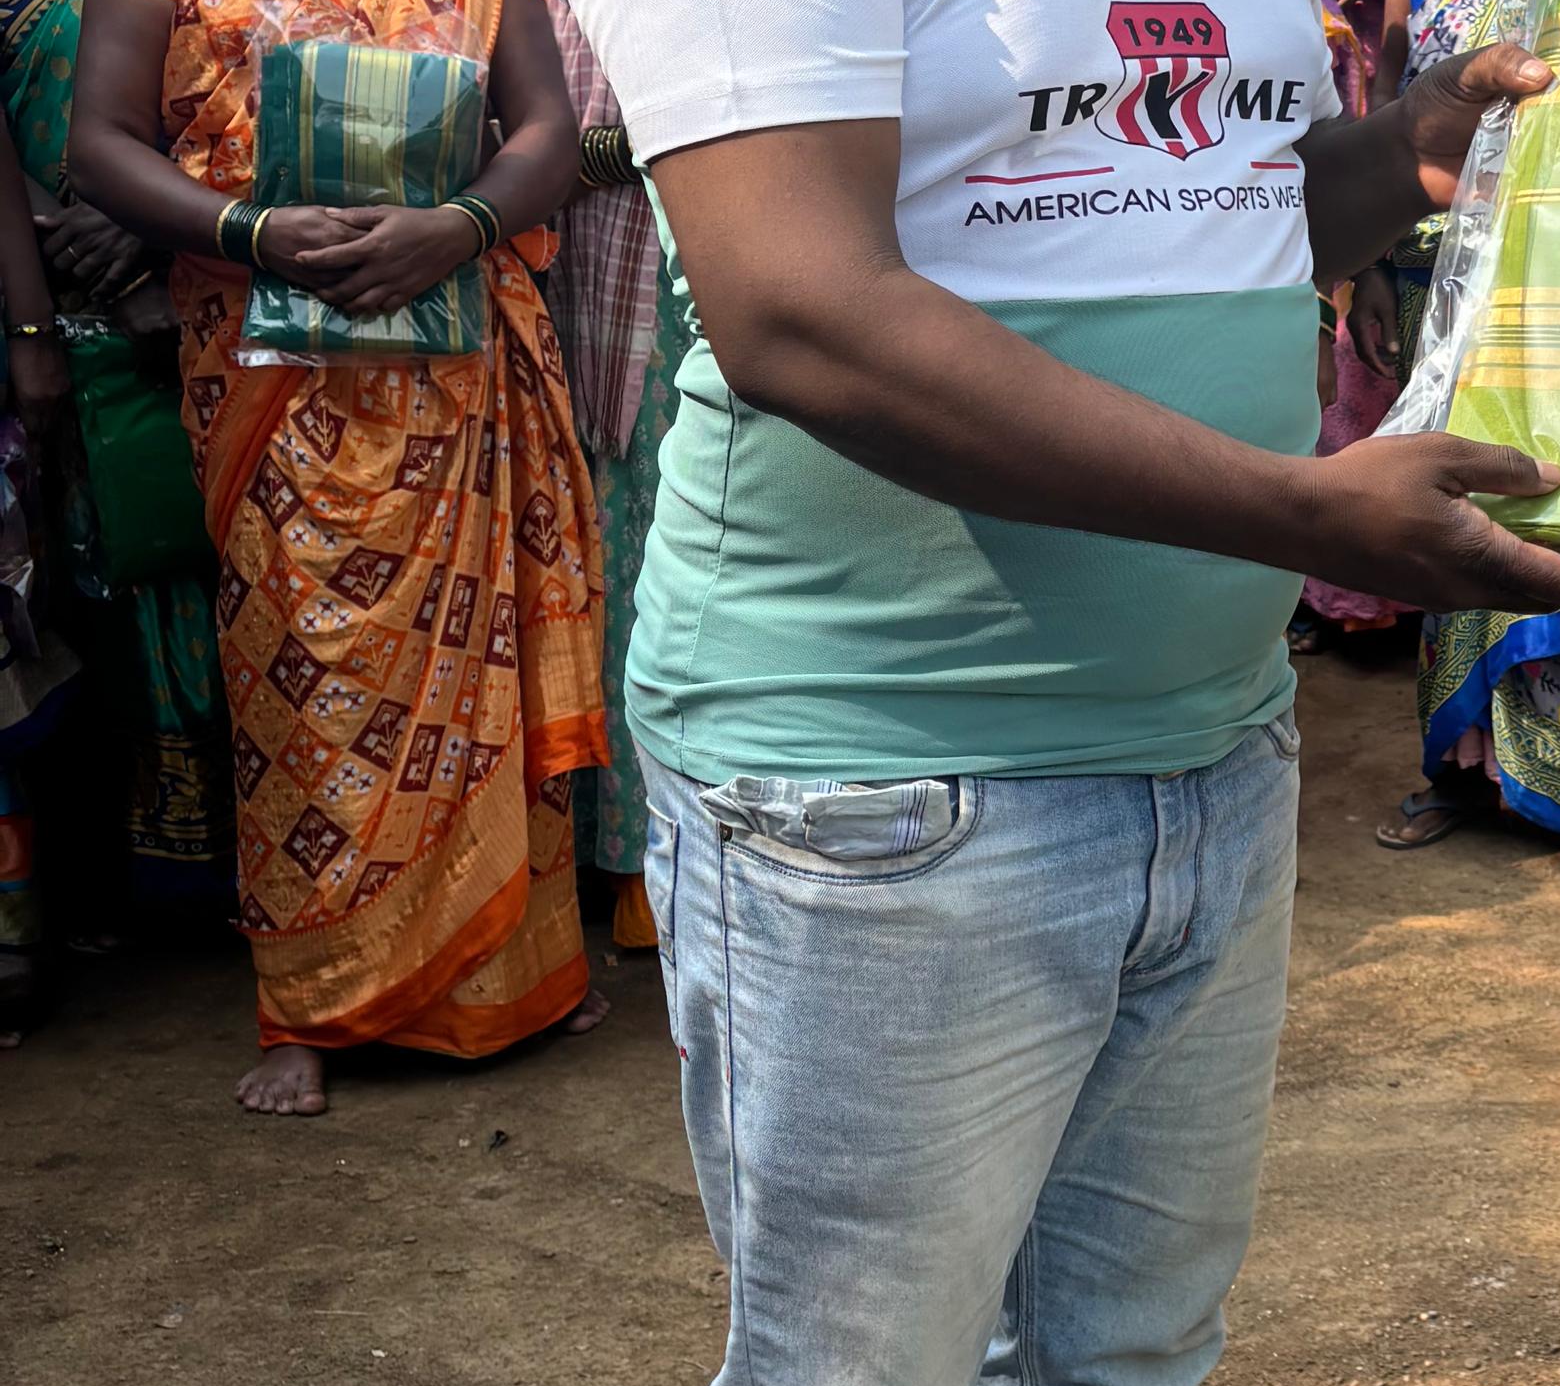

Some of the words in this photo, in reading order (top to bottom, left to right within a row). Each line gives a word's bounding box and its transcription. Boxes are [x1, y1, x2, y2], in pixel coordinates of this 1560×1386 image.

[1123, 18, 1212, 47] 1949
[964, 188, 1171, 226] AMERICAN
[1178, 186, 1269, 211] SPORTS
